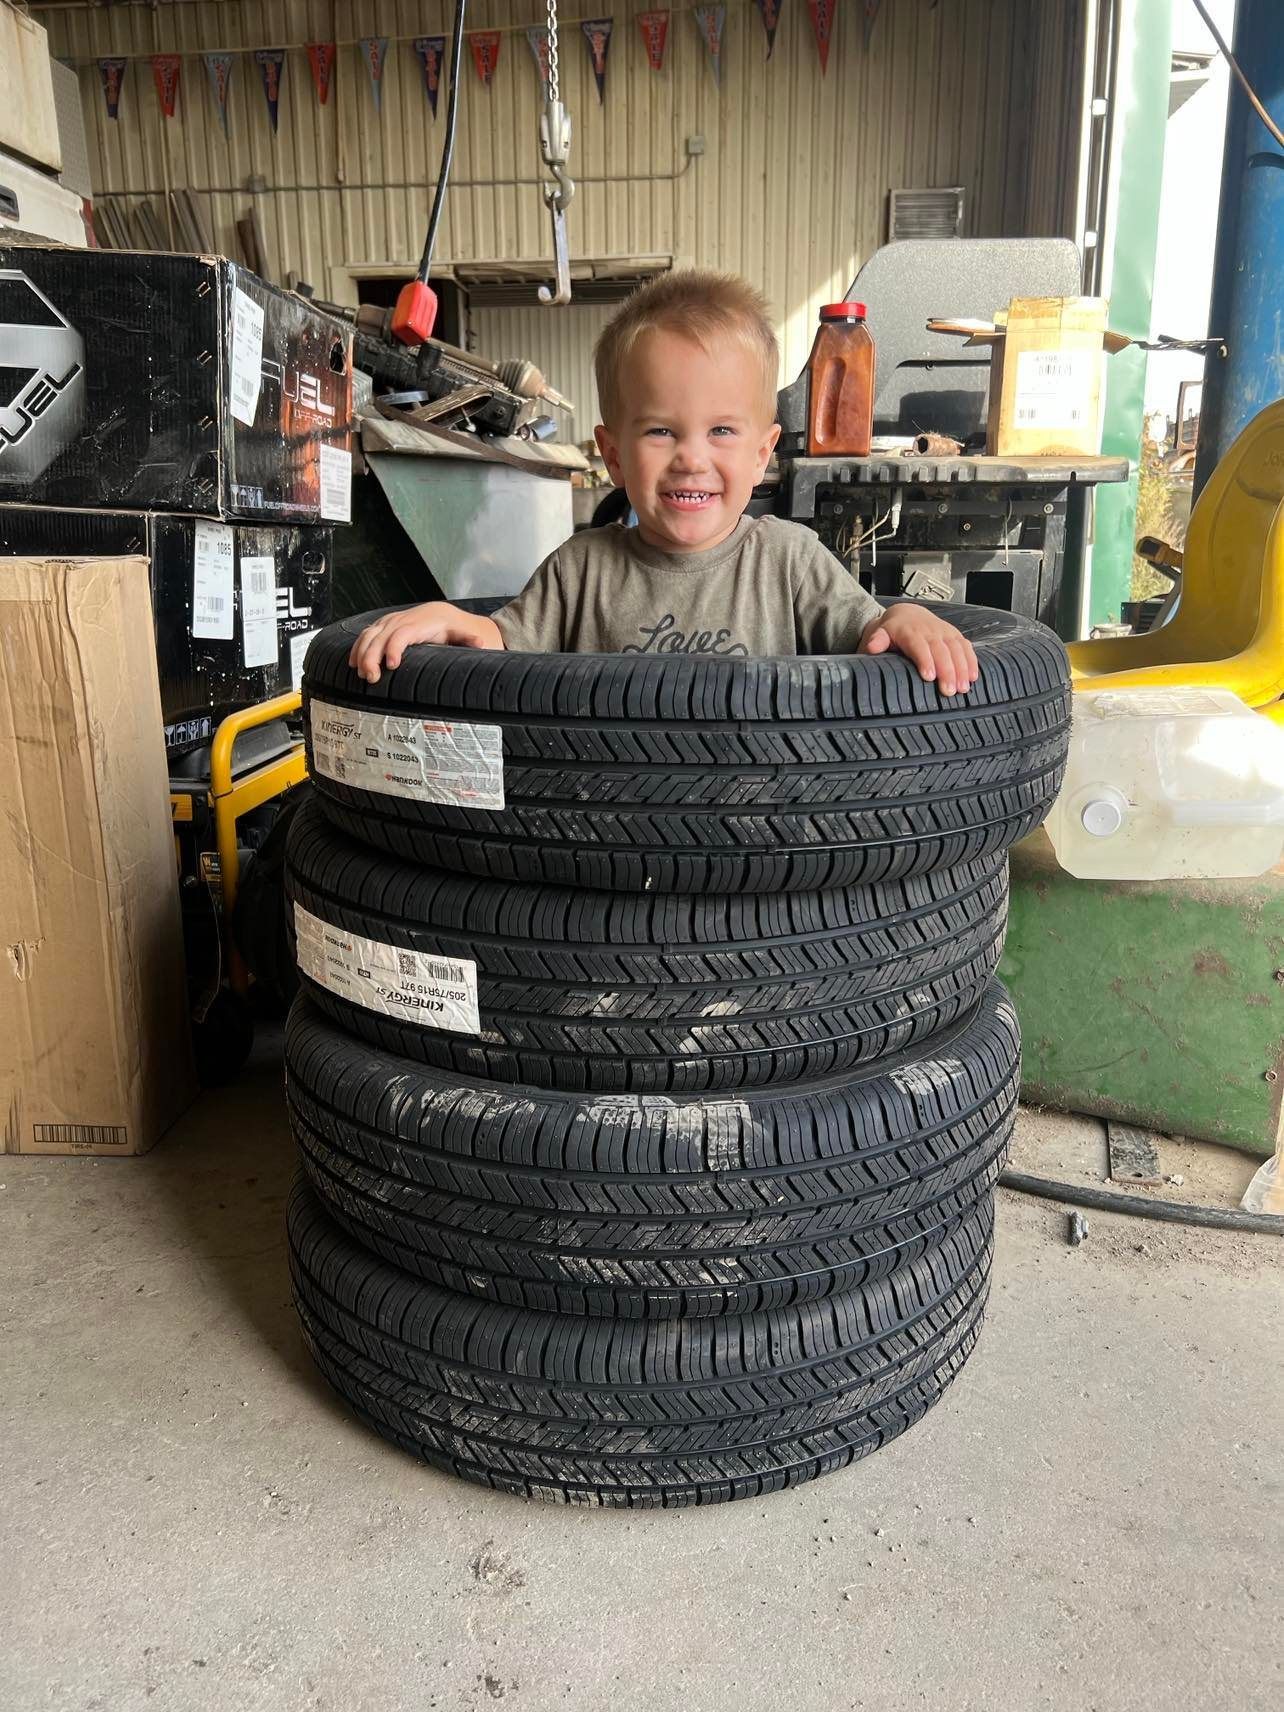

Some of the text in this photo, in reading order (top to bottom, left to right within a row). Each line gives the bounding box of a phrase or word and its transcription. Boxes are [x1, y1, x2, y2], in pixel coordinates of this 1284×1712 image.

[0, 362, 84, 456] UEL
[385, 991, 444, 1012] KINERGY
[417, 984, 467, 1001] 205/75R15
